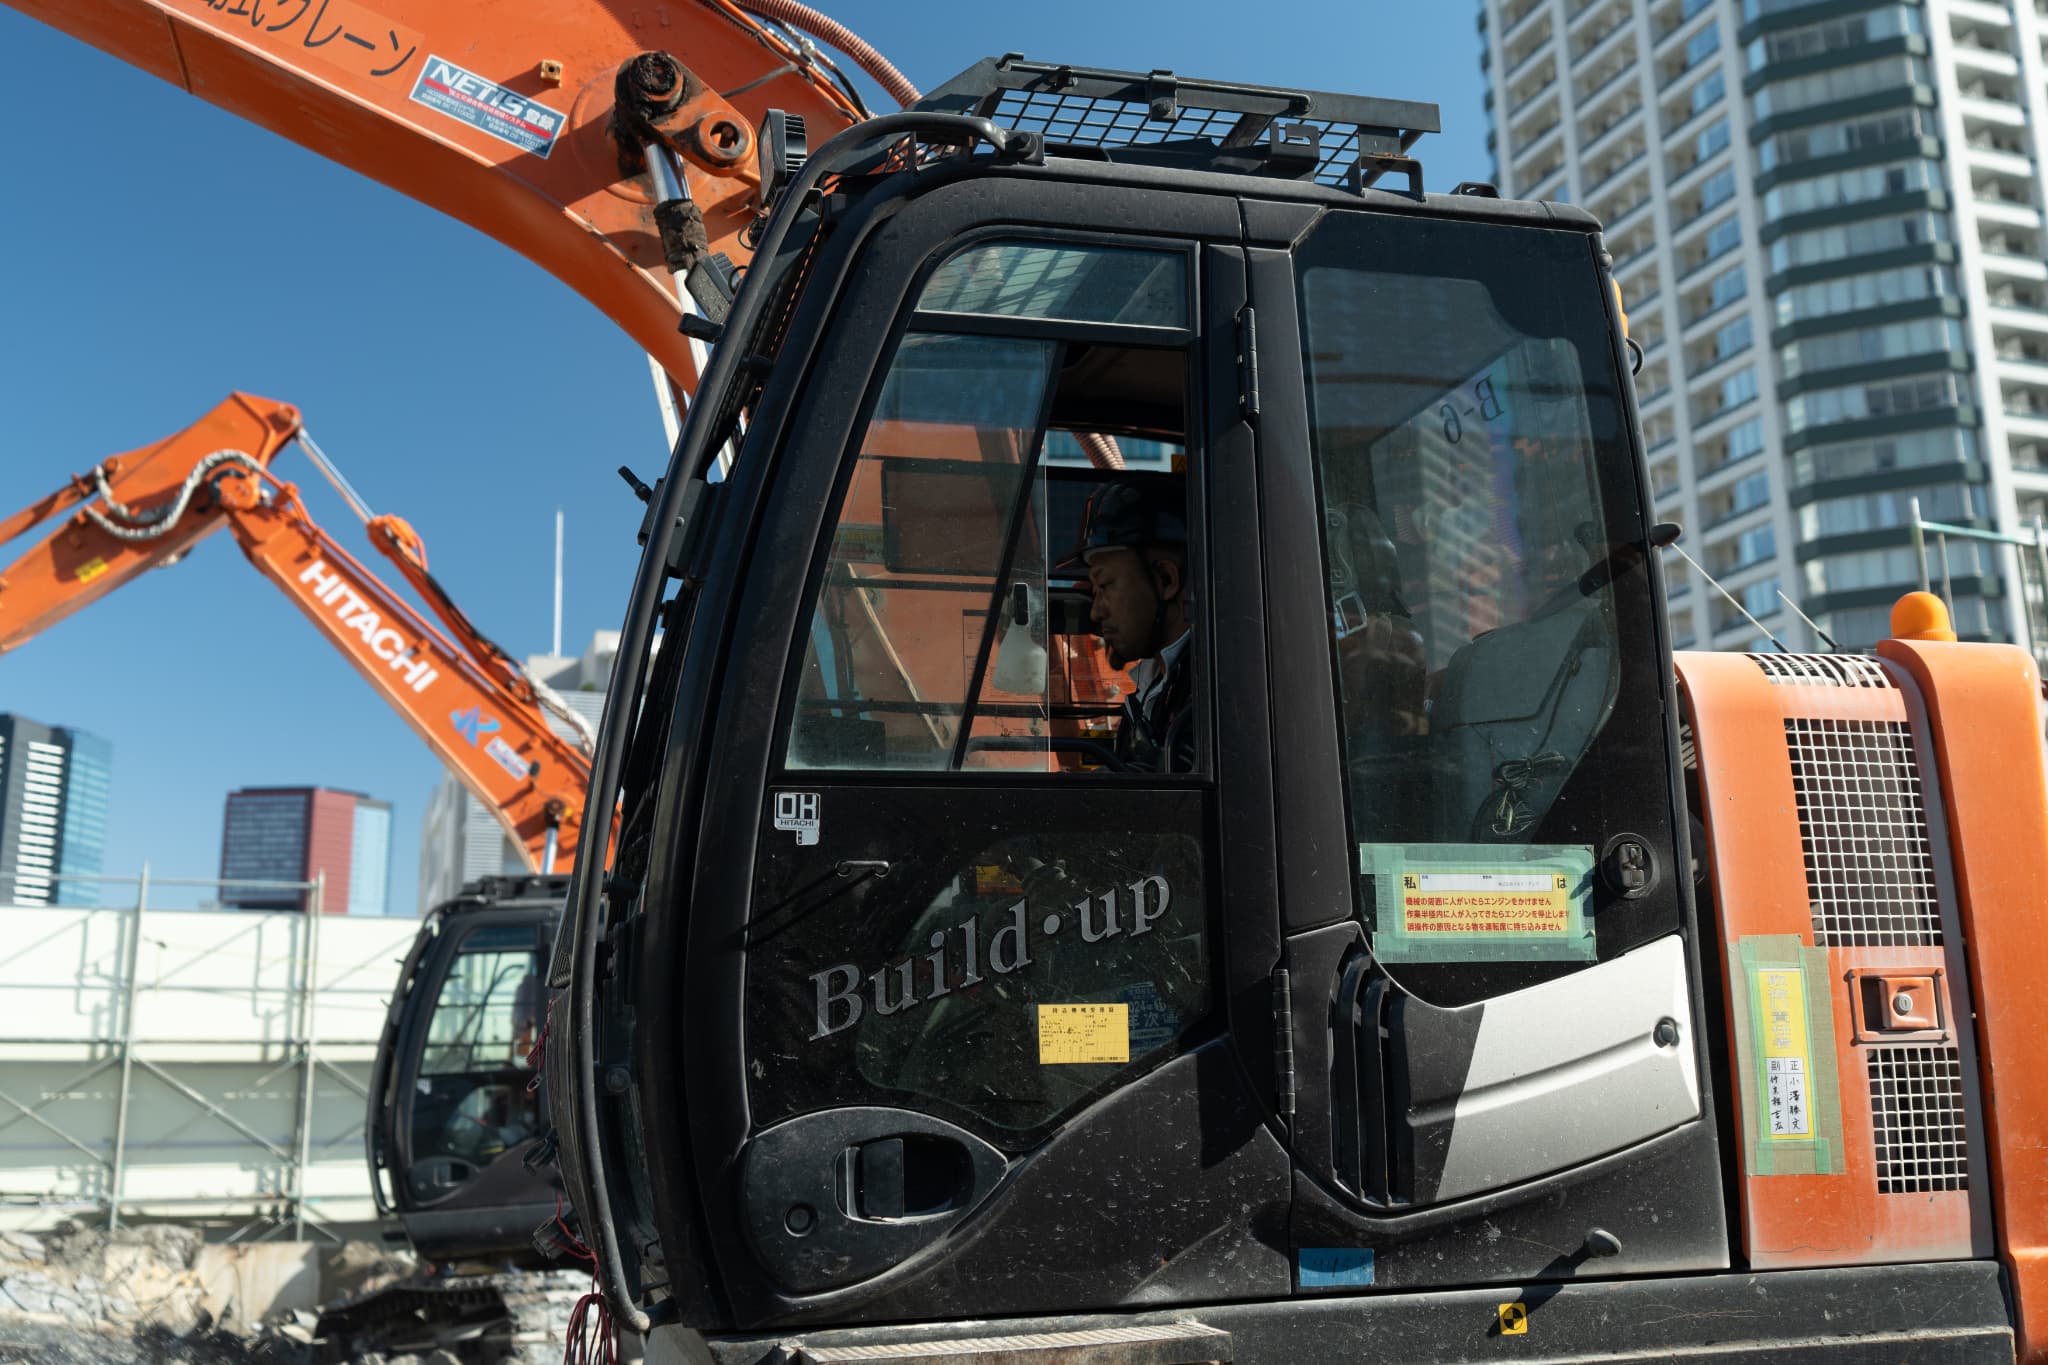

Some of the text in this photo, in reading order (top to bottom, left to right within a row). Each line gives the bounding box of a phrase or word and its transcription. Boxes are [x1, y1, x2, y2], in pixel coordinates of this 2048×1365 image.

[430, 63, 528, 117] NETIS
[299, 559, 438, 693] HITACHI
[780, 819, 814, 827] HITACHI
[1404, 876, 1567, 889] 私 は
[1789, 1060, 1800, 1071] 正
